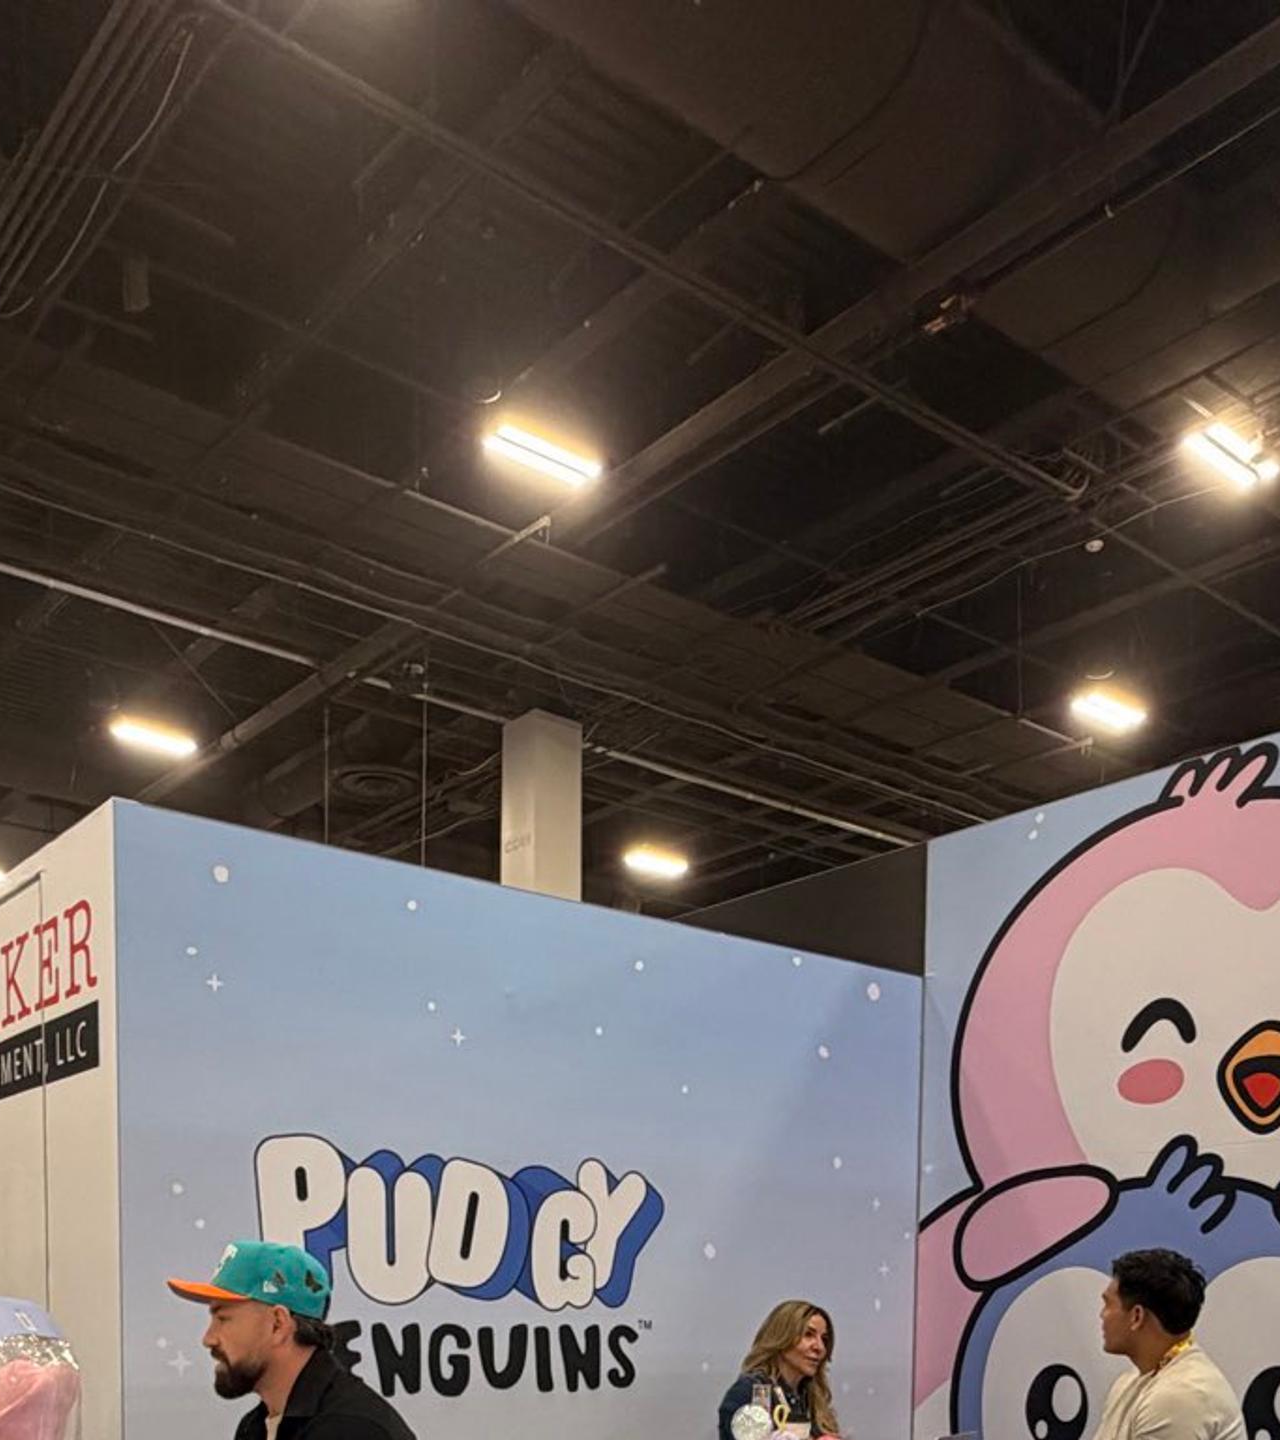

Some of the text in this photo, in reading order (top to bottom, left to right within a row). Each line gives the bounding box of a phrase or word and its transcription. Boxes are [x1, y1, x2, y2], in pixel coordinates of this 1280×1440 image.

[55, 1020, 88, 1067] LLC
[254, 1133, 665, 1311] PUDGY
[328, 1318, 639, 1397] ENGUINS
